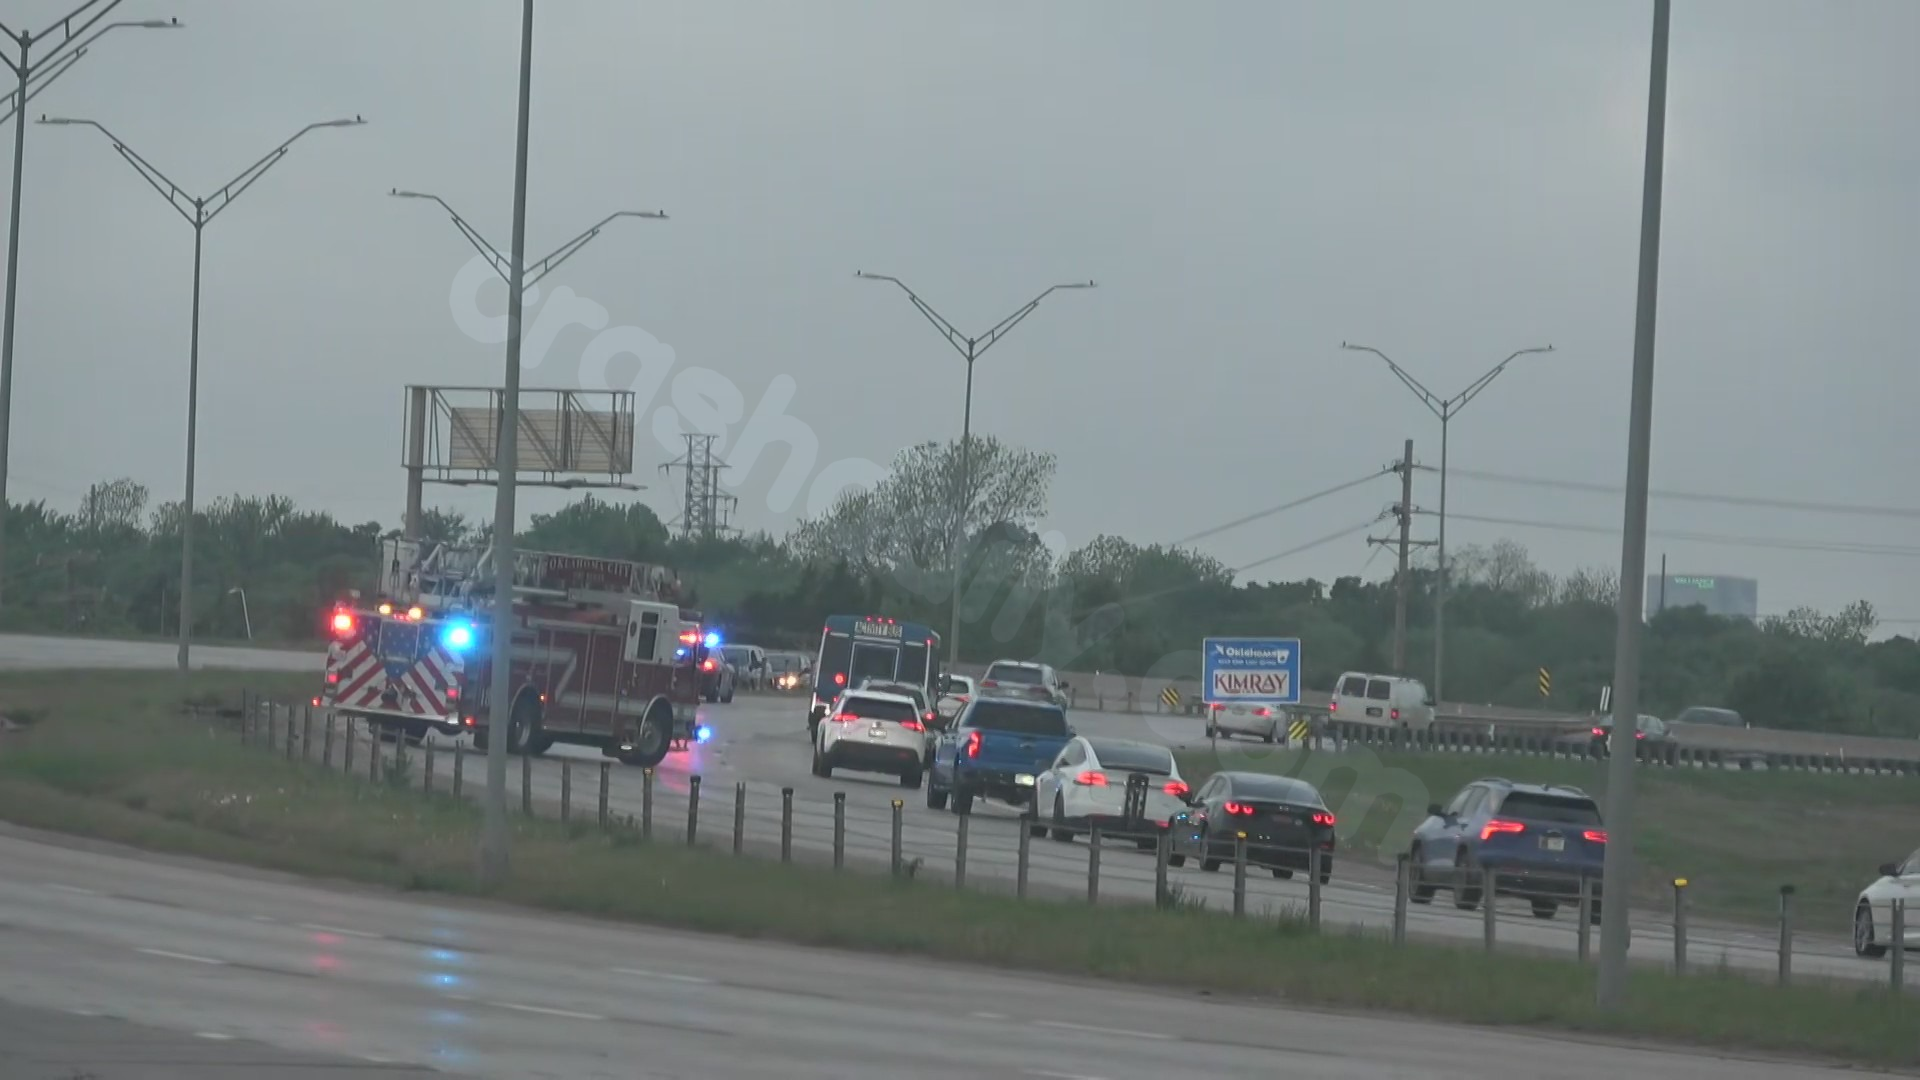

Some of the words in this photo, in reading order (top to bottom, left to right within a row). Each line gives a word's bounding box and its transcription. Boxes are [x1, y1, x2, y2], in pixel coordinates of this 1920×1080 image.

[549, 556, 605, 572] OKLAHOMA
[607, 563, 631, 578] CITY
[1215, 674, 1287, 694] KIMRAY
